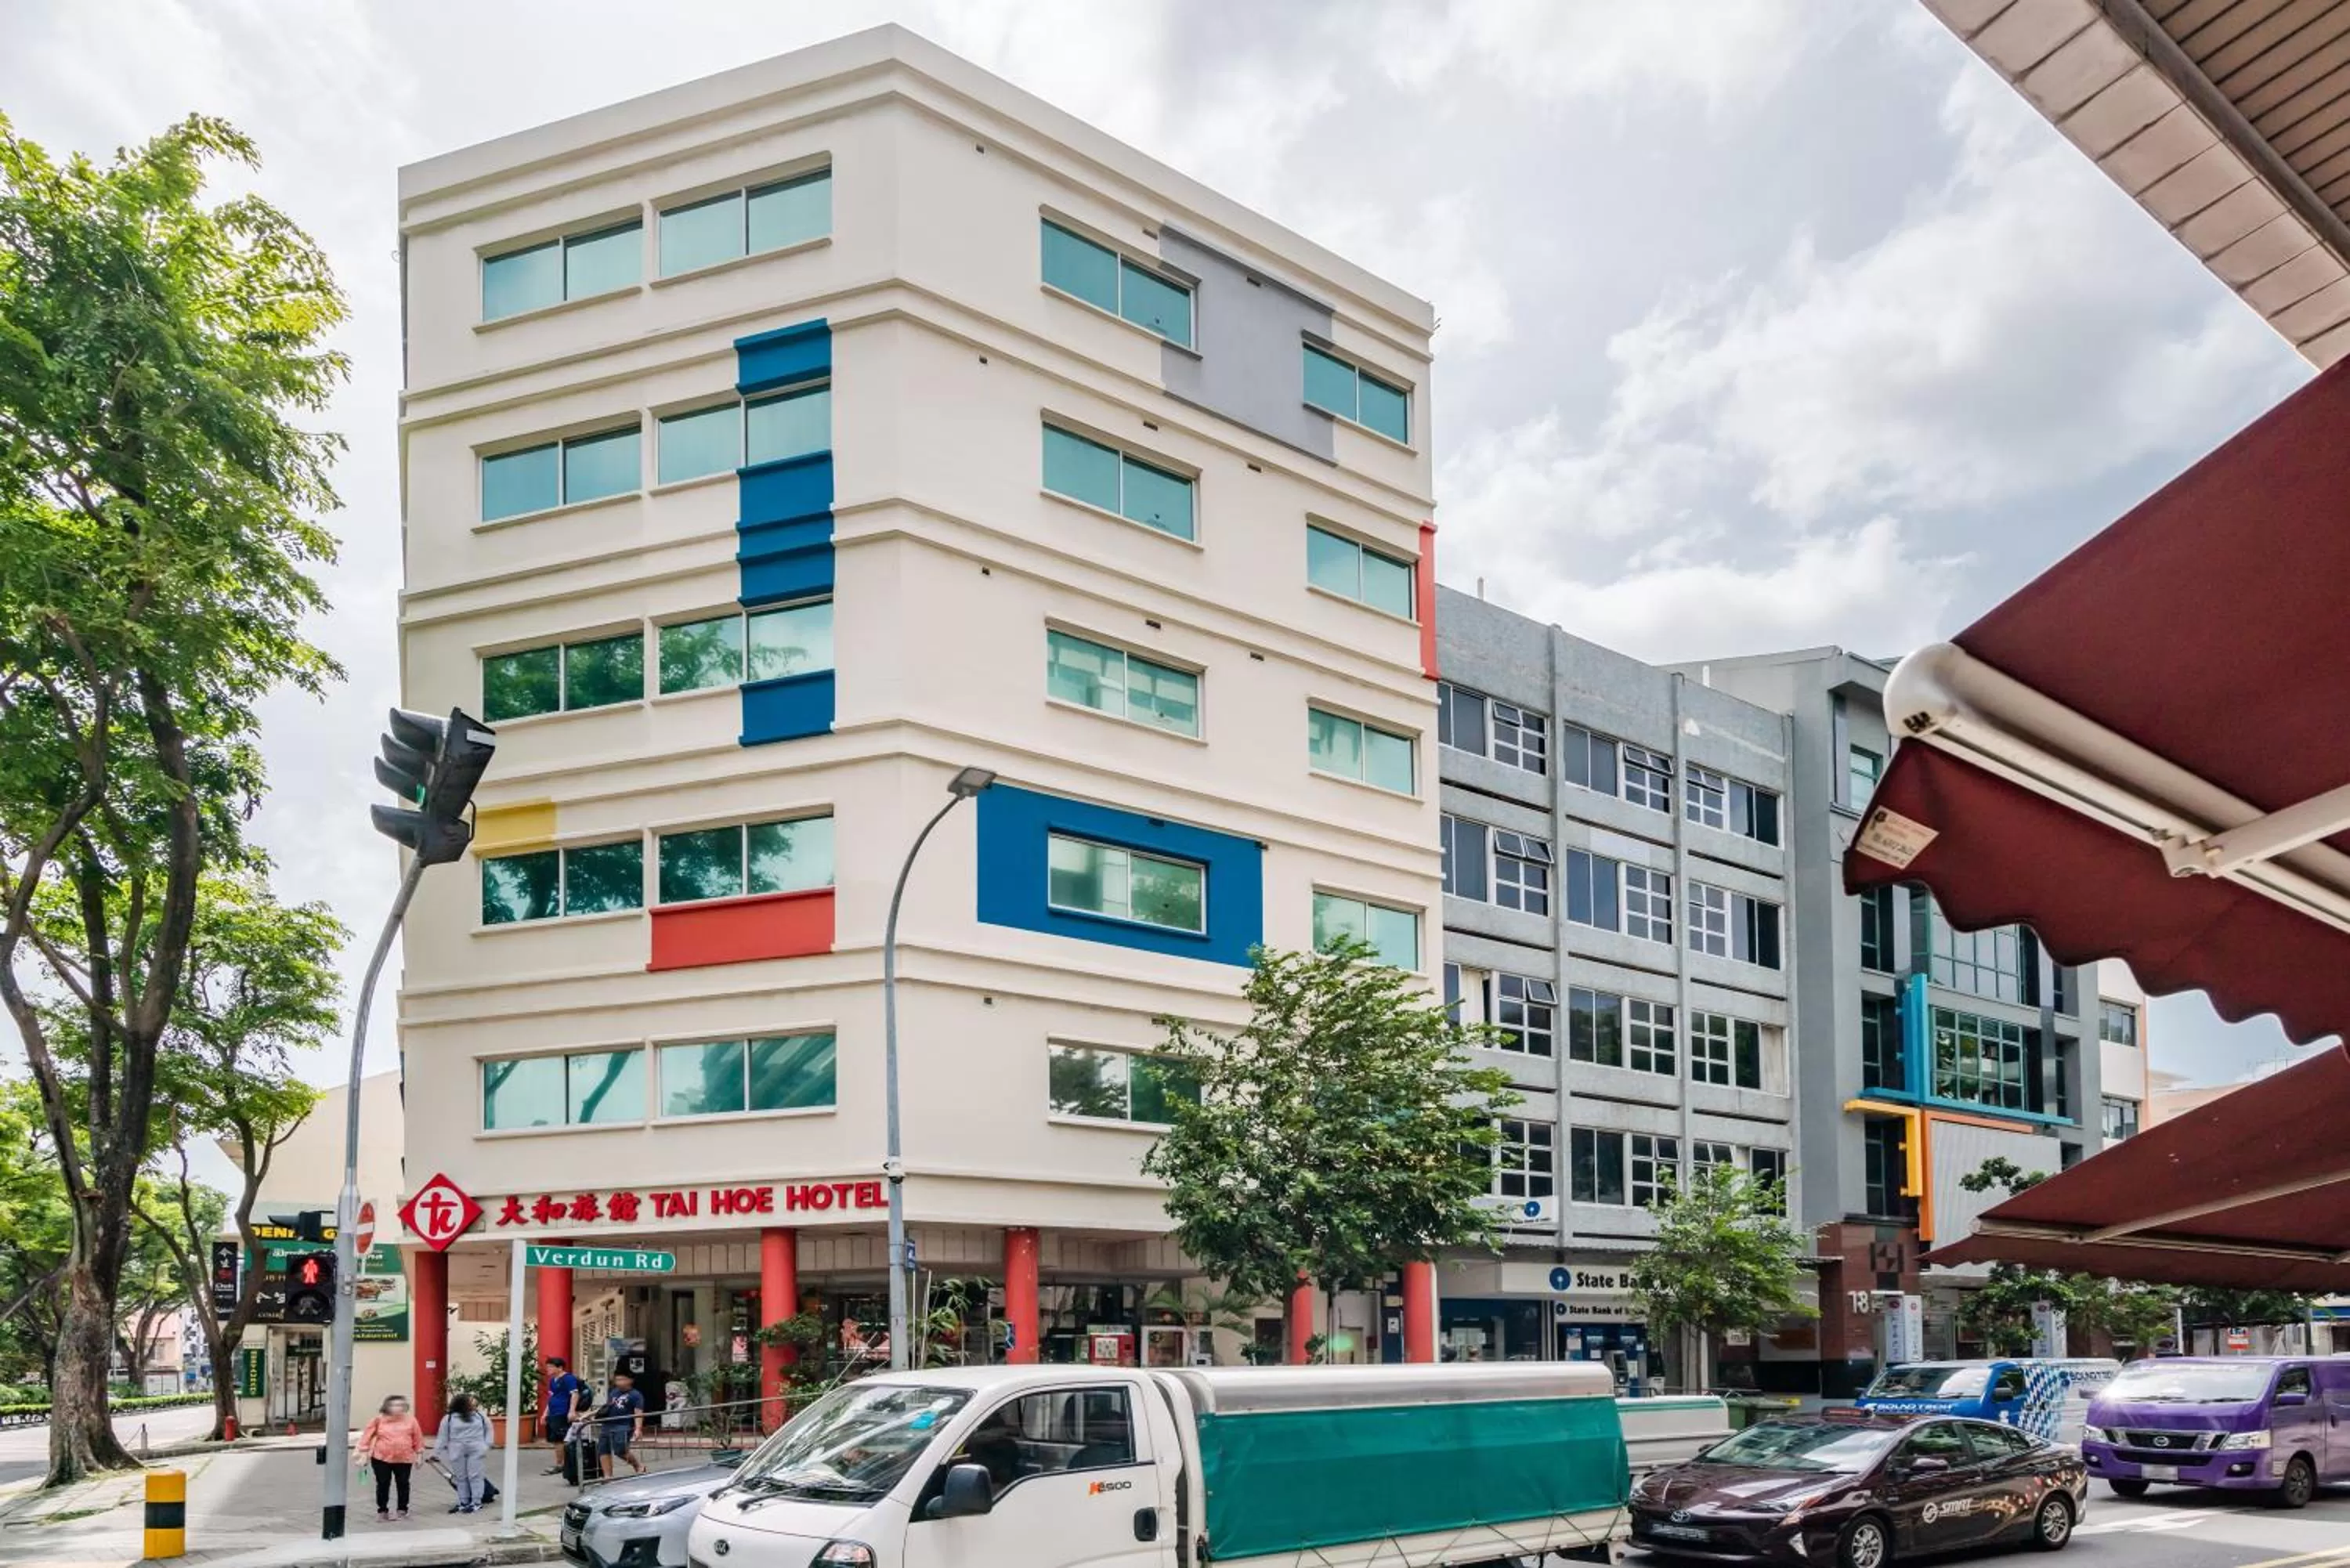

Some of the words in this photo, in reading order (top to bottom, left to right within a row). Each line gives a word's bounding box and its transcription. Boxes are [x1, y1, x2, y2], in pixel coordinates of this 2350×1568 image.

[497, 1191, 640, 1226] 大和旅館
[649, 1190, 697, 1218] TAI
[710, 1187, 774, 1215] HOE
[786, 1181, 888, 1211] HOTEL
[534, 1248, 624, 1266] Verdun
[635, 1253, 663, 1268] Rd
[1576, 1272, 1614, 1288] State
[1619, 1274, 1648, 1288] Ba
[1569, 1306, 1589, 1314] State
[1593, 1306, 1612, 1315] Bank
[1614, 1306, 1624, 1315] of
